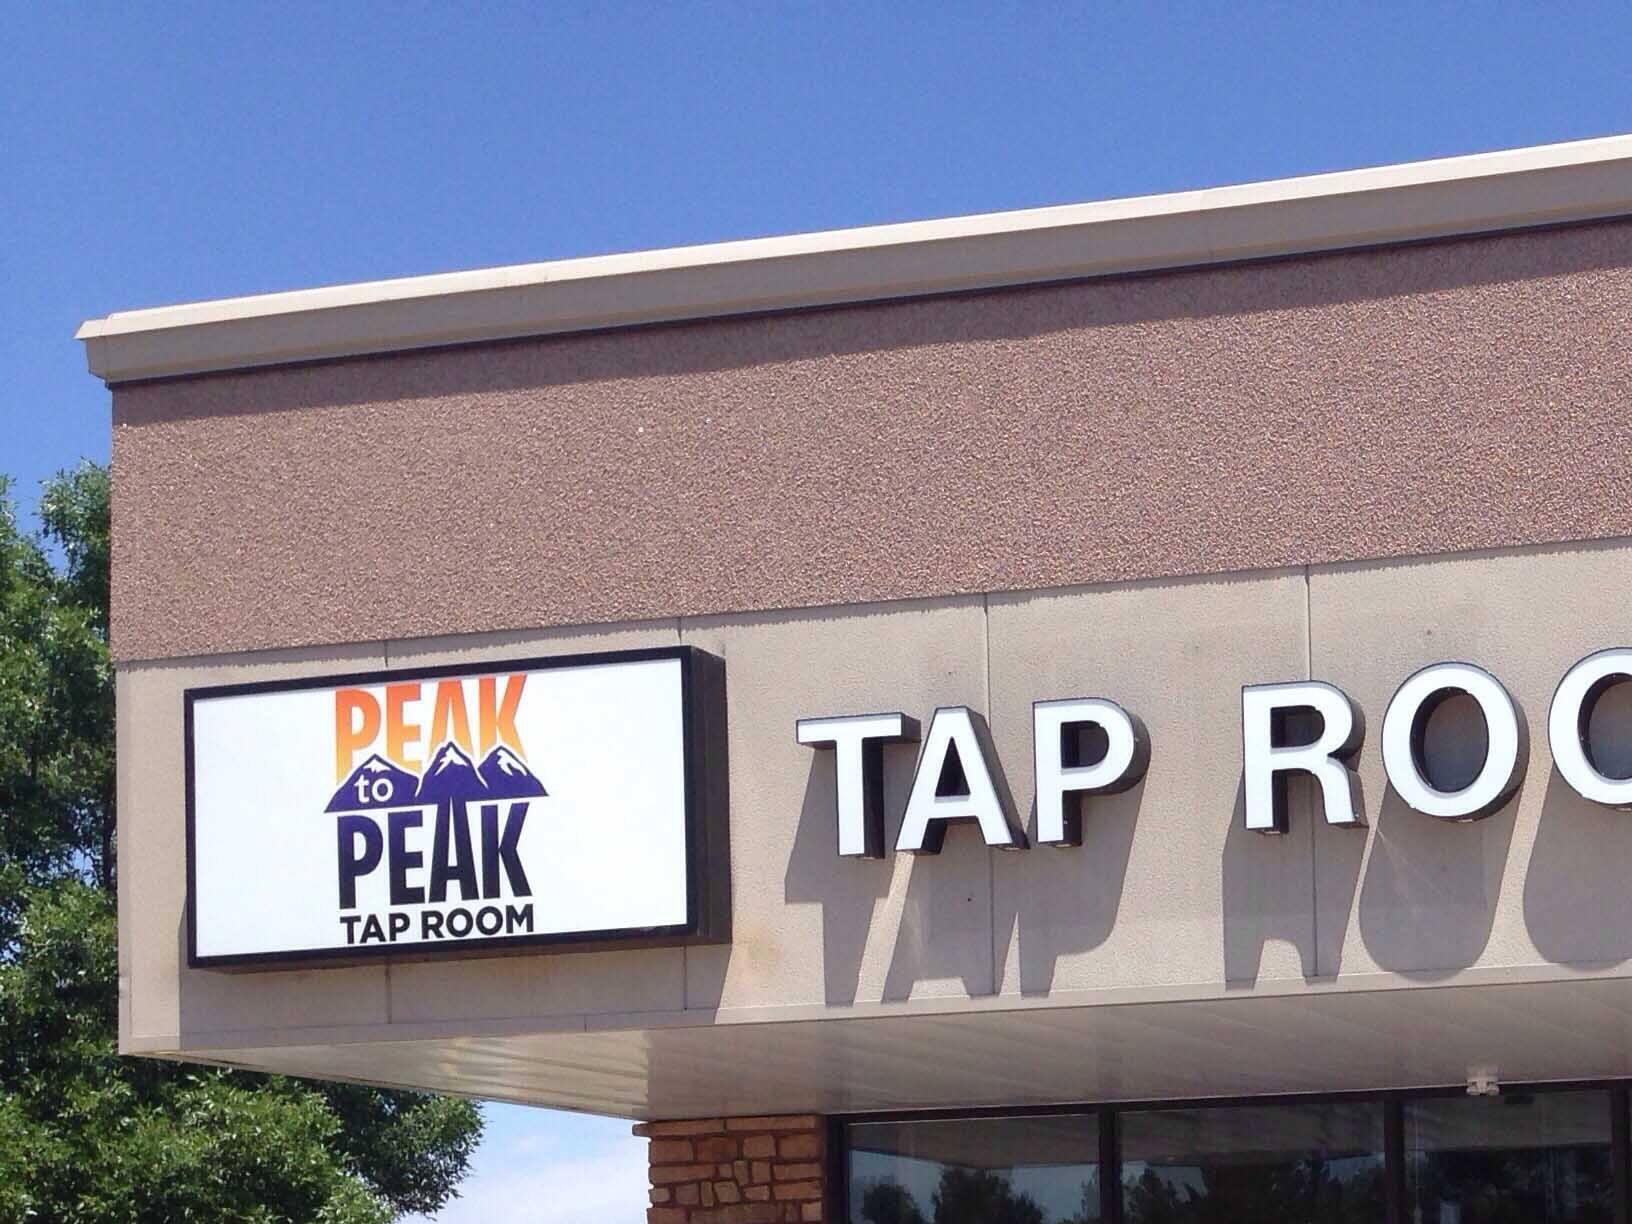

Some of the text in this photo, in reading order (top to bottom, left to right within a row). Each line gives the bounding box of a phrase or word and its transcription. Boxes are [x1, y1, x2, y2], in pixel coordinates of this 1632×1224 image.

[334, 673, 528, 784] PEAK
[795, 696, 1152, 860] TAP
[354, 771, 393, 804] to
[337, 797, 533, 910] PEAK
[339, 904, 535, 944] TAP ROOM
